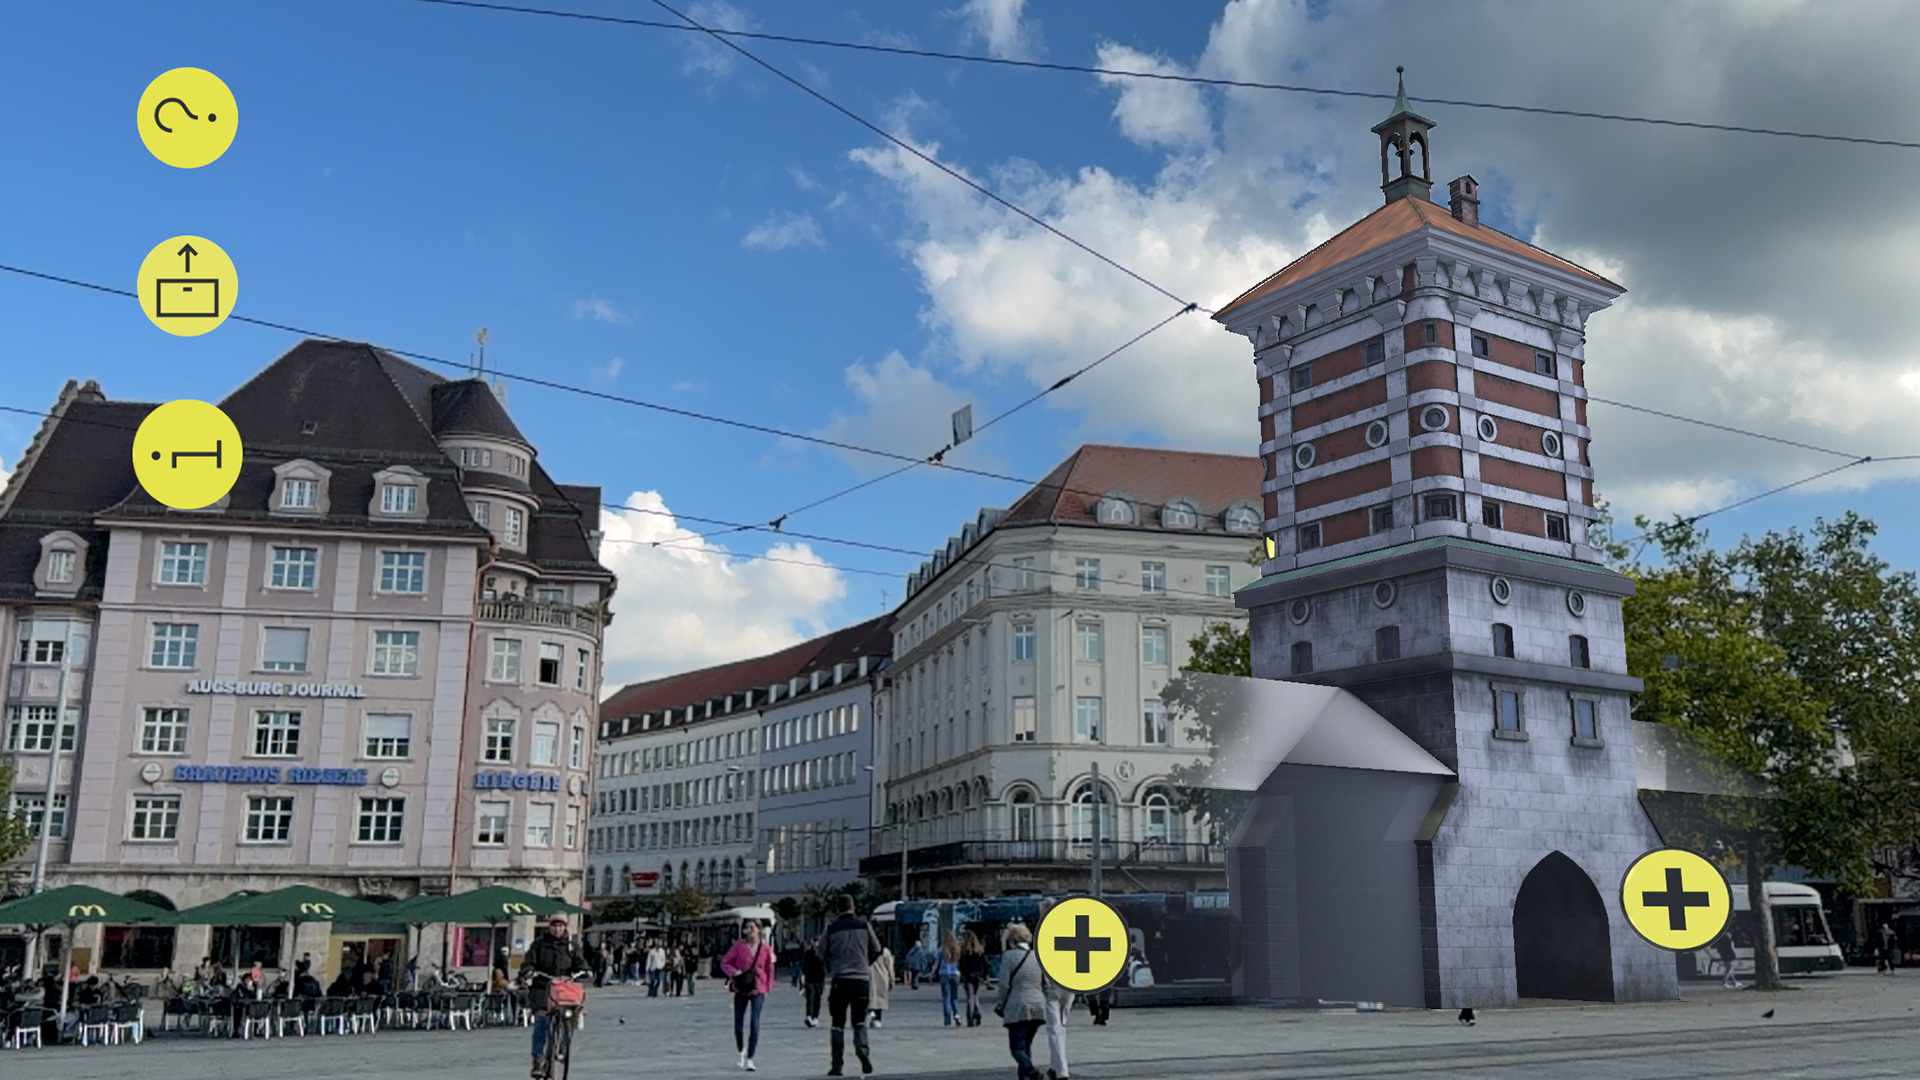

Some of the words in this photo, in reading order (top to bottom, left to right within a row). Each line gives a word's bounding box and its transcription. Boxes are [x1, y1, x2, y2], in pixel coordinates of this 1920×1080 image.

[187, 678, 284, 696] AUGSBURG
[289, 683, 366, 699] JOURNAL
[174, 765, 280, 784] BRAUHAUS
[475, 772, 562, 792] RIEGELE
